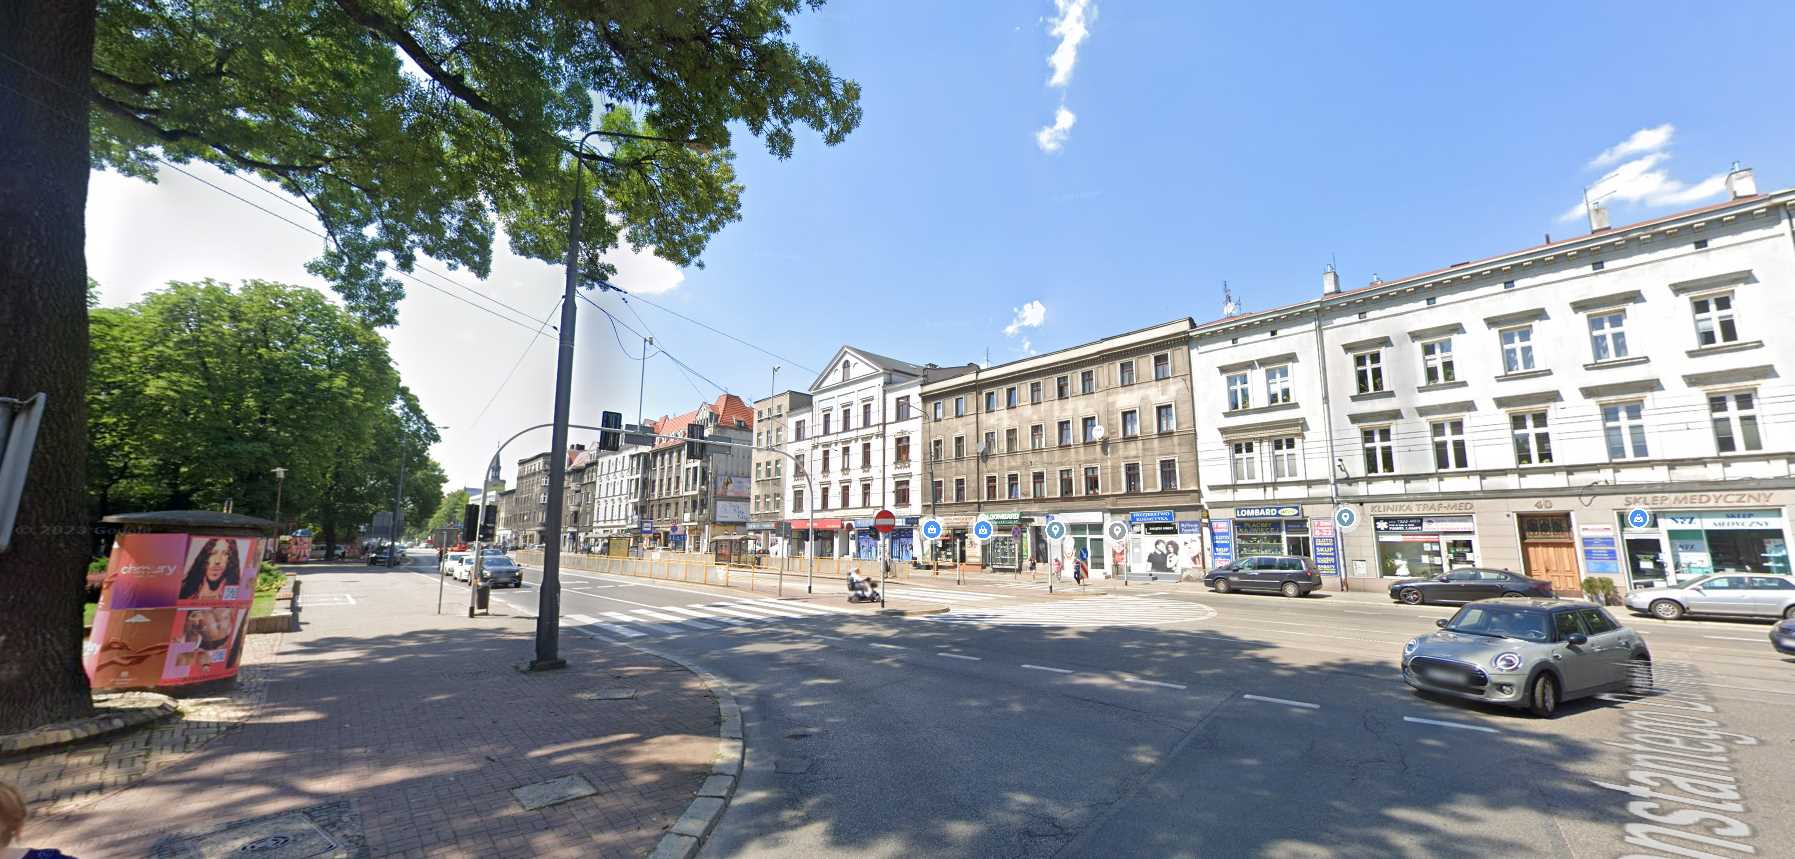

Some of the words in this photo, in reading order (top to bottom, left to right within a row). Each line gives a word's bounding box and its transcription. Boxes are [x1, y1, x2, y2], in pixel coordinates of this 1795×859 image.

[1623, 495, 1668, 506] SKLEP
[1672, 492, 1774, 504] MEDYCZNY
[1236, 508, 1277, 517] LOMBARD
[1370, 503, 1413, 513] KLINIKA
